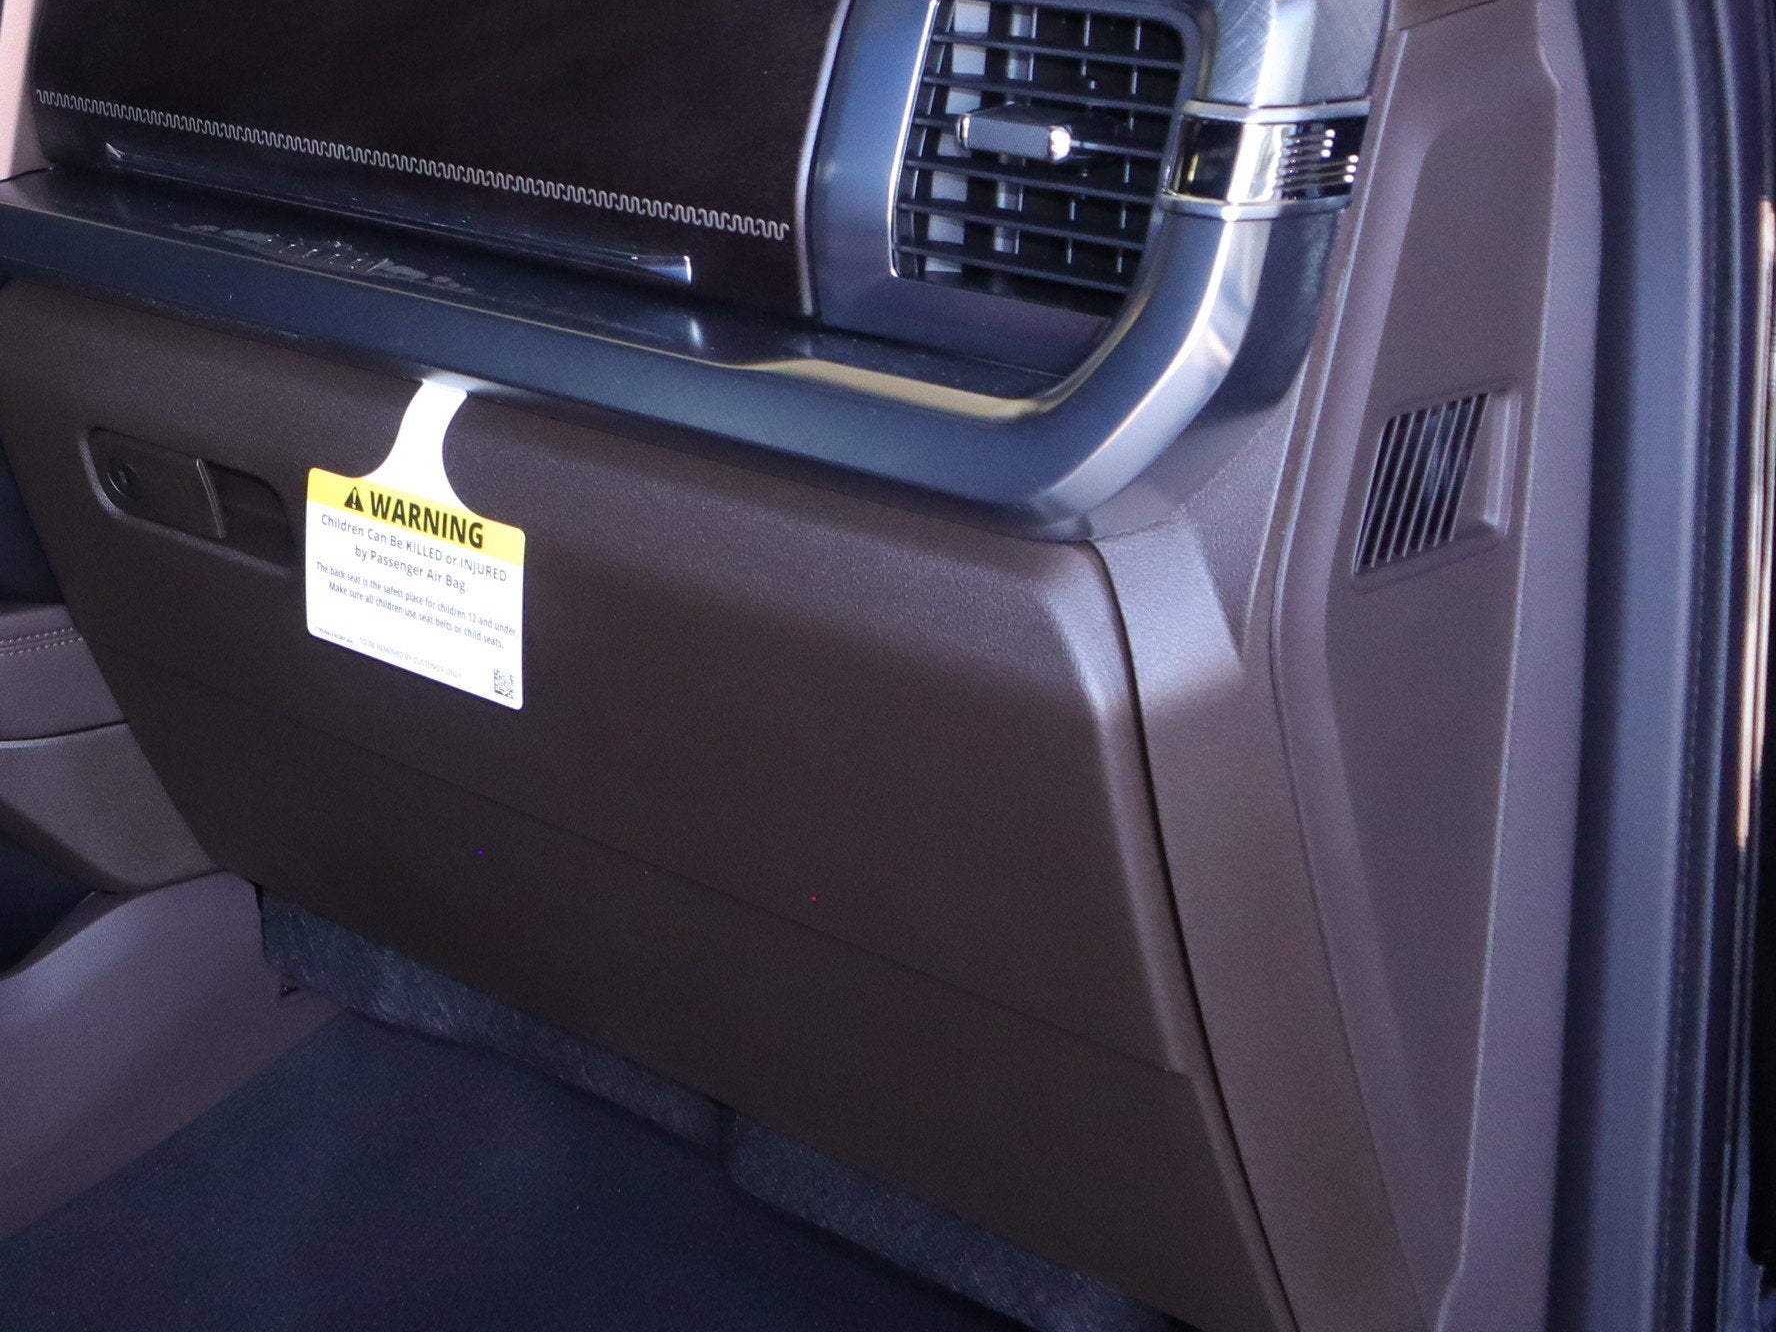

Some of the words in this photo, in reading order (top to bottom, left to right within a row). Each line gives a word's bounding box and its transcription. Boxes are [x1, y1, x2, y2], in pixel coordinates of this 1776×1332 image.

[321, 513, 364, 537] Children
[367, 528, 387, 544] Can
[390, 535, 403, 549] Be
[406, 538, 443, 561] KILLED
[446, 554, 457, 565] or
[460, 556, 508, 582] INJURED
[370, 490, 484, 549] WARNING
[316, 561, 328, 574] The
[329, 565, 345, 579] back
[347, 571, 361, 584] seat
[363, 576, 369, 587] is
[370, 578, 381, 591] the
[383, 583, 404, 599] safest
[405, 589, 423, 605] place
[425, 597, 436, 609] for
[437, 602, 466, 620] children
[468, 612, 476, 623] 12
[479, 615, 493, 628] and
[355, 545, 367, 561] by
[370, 549, 424, 577] Passenger
[427, 568, 442, 583] Air
[446, 574, 469, 594] Bag.
[329, 581, 347, 595] Make
[349, 588, 364, 601] sure
[365, 592, 374, 605] all
[375, 596, 403, 614] children
[404, 608, 417, 619] use
[419, 611, 433, 624] seat
[435, 616, 453, 631] belts
[454, 624, 462, 634] or
[464, 625, 481, 642] child
